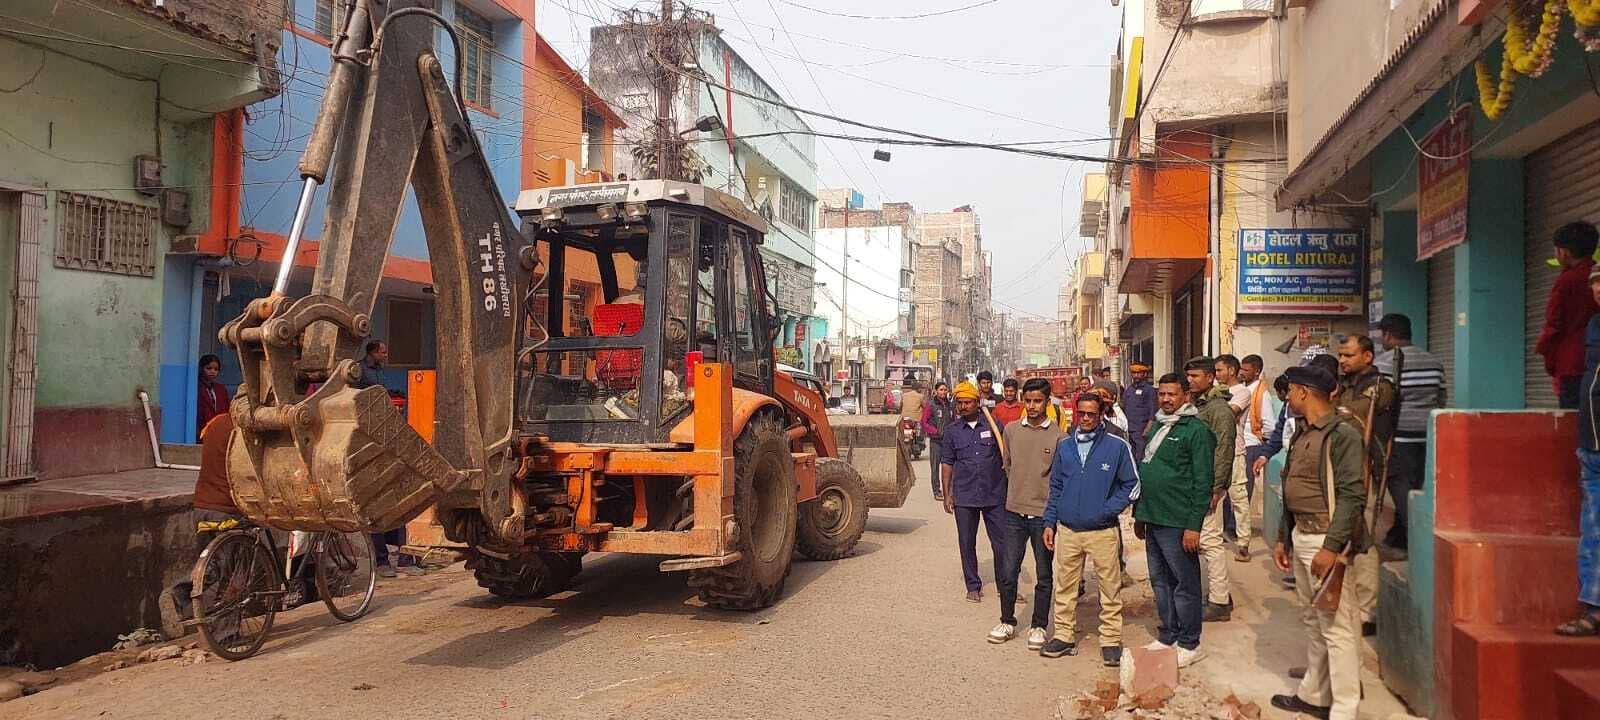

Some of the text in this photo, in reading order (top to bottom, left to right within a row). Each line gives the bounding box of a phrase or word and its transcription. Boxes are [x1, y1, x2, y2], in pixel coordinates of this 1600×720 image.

[1268, 230, 1303, 247] होटल
[1332, 233, 1358, 246] राज
[1246, 252, 1355, 266] HOTEL RITURAJ
[479, 233, 497, 311] TH 86
[1264, 276, 1283, 284] NON
[793, 390, 811, 409] TATA
